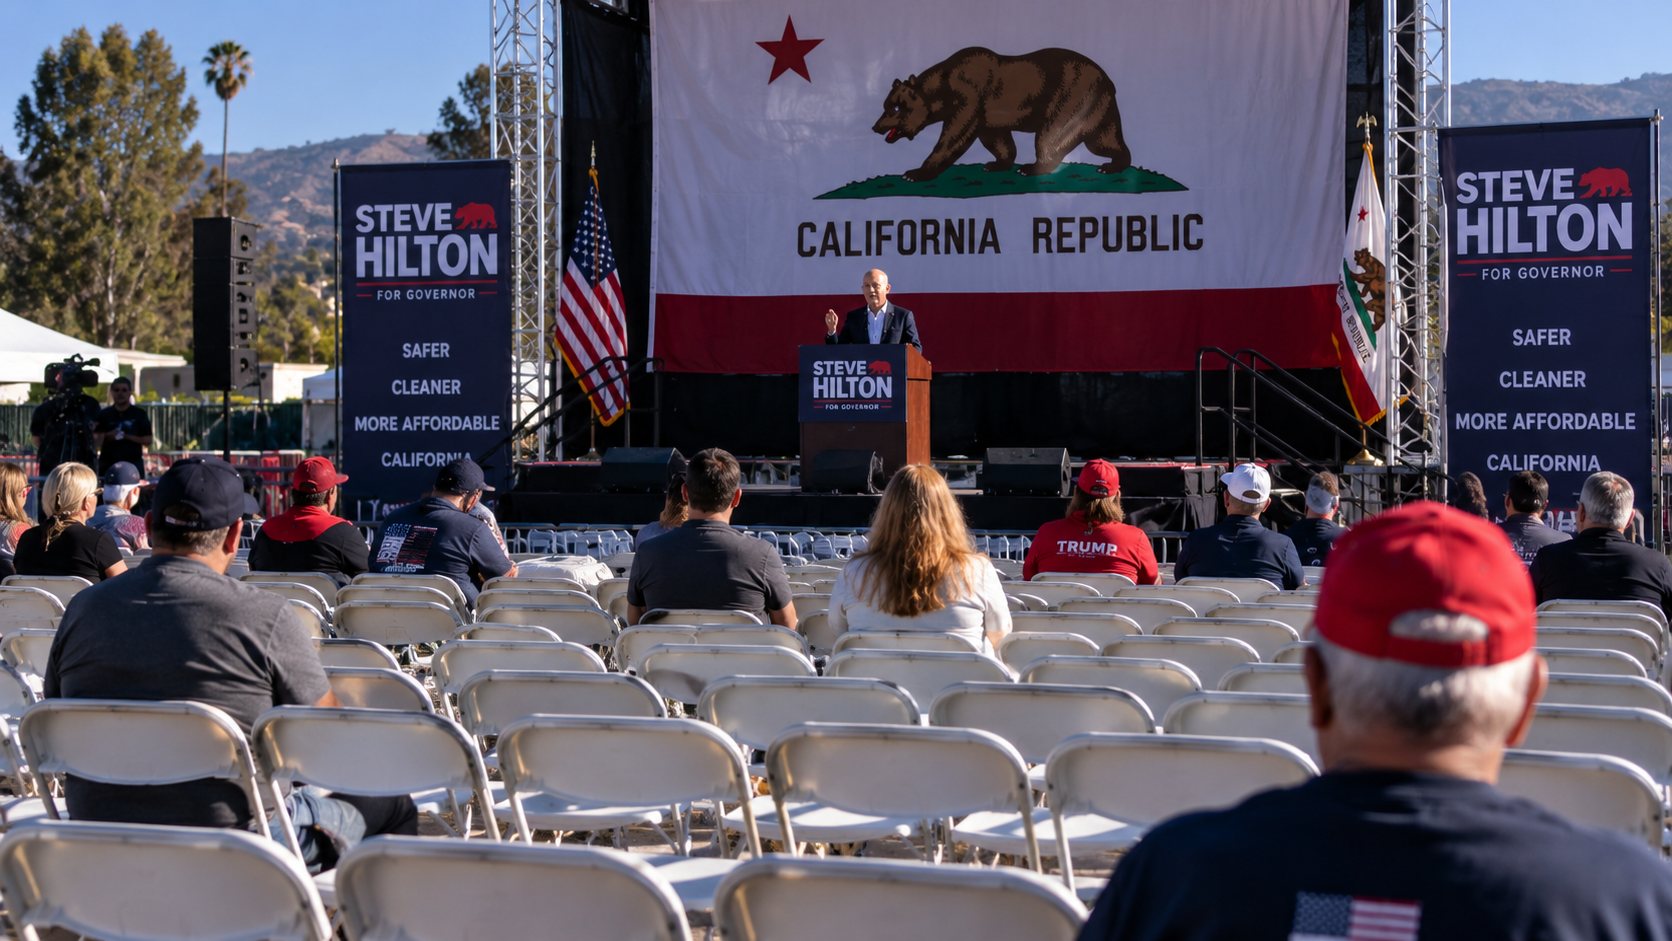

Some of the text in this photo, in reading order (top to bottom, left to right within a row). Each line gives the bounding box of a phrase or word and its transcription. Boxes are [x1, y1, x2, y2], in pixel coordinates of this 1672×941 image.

[1456, 168, 1574, 204] STEVE
[356, 203, 452, 232] STEVE
[797, 213, 1203, 257] CALIFORNIA REPUBLIC
[1457, 202, 1632, 255] HILTON
[356, 234, 498, 278] HILTON
[1482, 266, 1604, 281] FOR GOVERNOR
[377, 288, 475, 300] FOR GOVERNOR
[1512, 328, 1571, 346] SAFER
[402, 343, 450, 358] SAFER
[813, 361, 867, 375] STEVE
[391, 379, 462, 395] CLEANER
[813, 376, 892, 398] HILTON
[1499, 371, 1586, 388] CLEANER
[355, 416, 500, 431] MORE AFFORDABLE
[1455, 413, 1636, 430] MORE AFFORDABLE
[1486, 454, 1601, 471] CALIFORNIA
[1057, 541, 1118, 555] TRUMP
